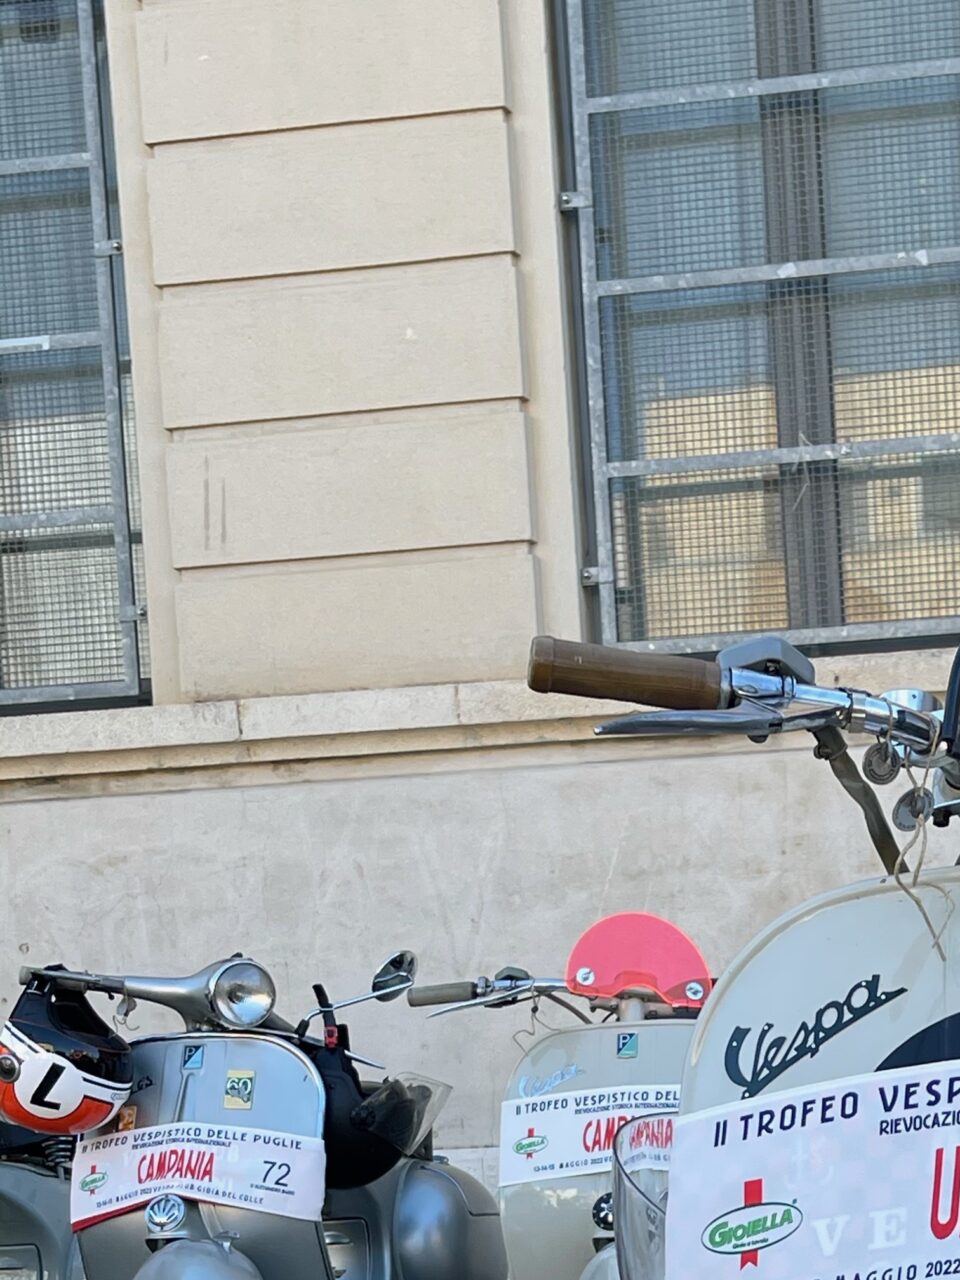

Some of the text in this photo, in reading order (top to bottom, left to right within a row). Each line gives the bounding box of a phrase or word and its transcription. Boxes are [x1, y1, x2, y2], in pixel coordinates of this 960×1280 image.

[724, 974, 908, 1100] Vespa
[525, 1098, 568, 1114] TROFEO
[575, 1091, 649, 1107] VESPISTICO
[655, 1091, 680, 1101] DEL
[714, 1121, 728, 1147] II
[740, 1092, 859, 1141] TROFEO
[90, 1136, 128, 1152] TROFEO
[133, 1127, 201, 1142] VESPISTICO
[207, 1129, 248, 1141] DELLE
[254, 1134, 302, 1150] PUGLIE
[138, 1148, 214, 1184] CAMPANIA
[262, 1160, 291, 1187] 72
[925, 1258, 960, 1278] 2022
